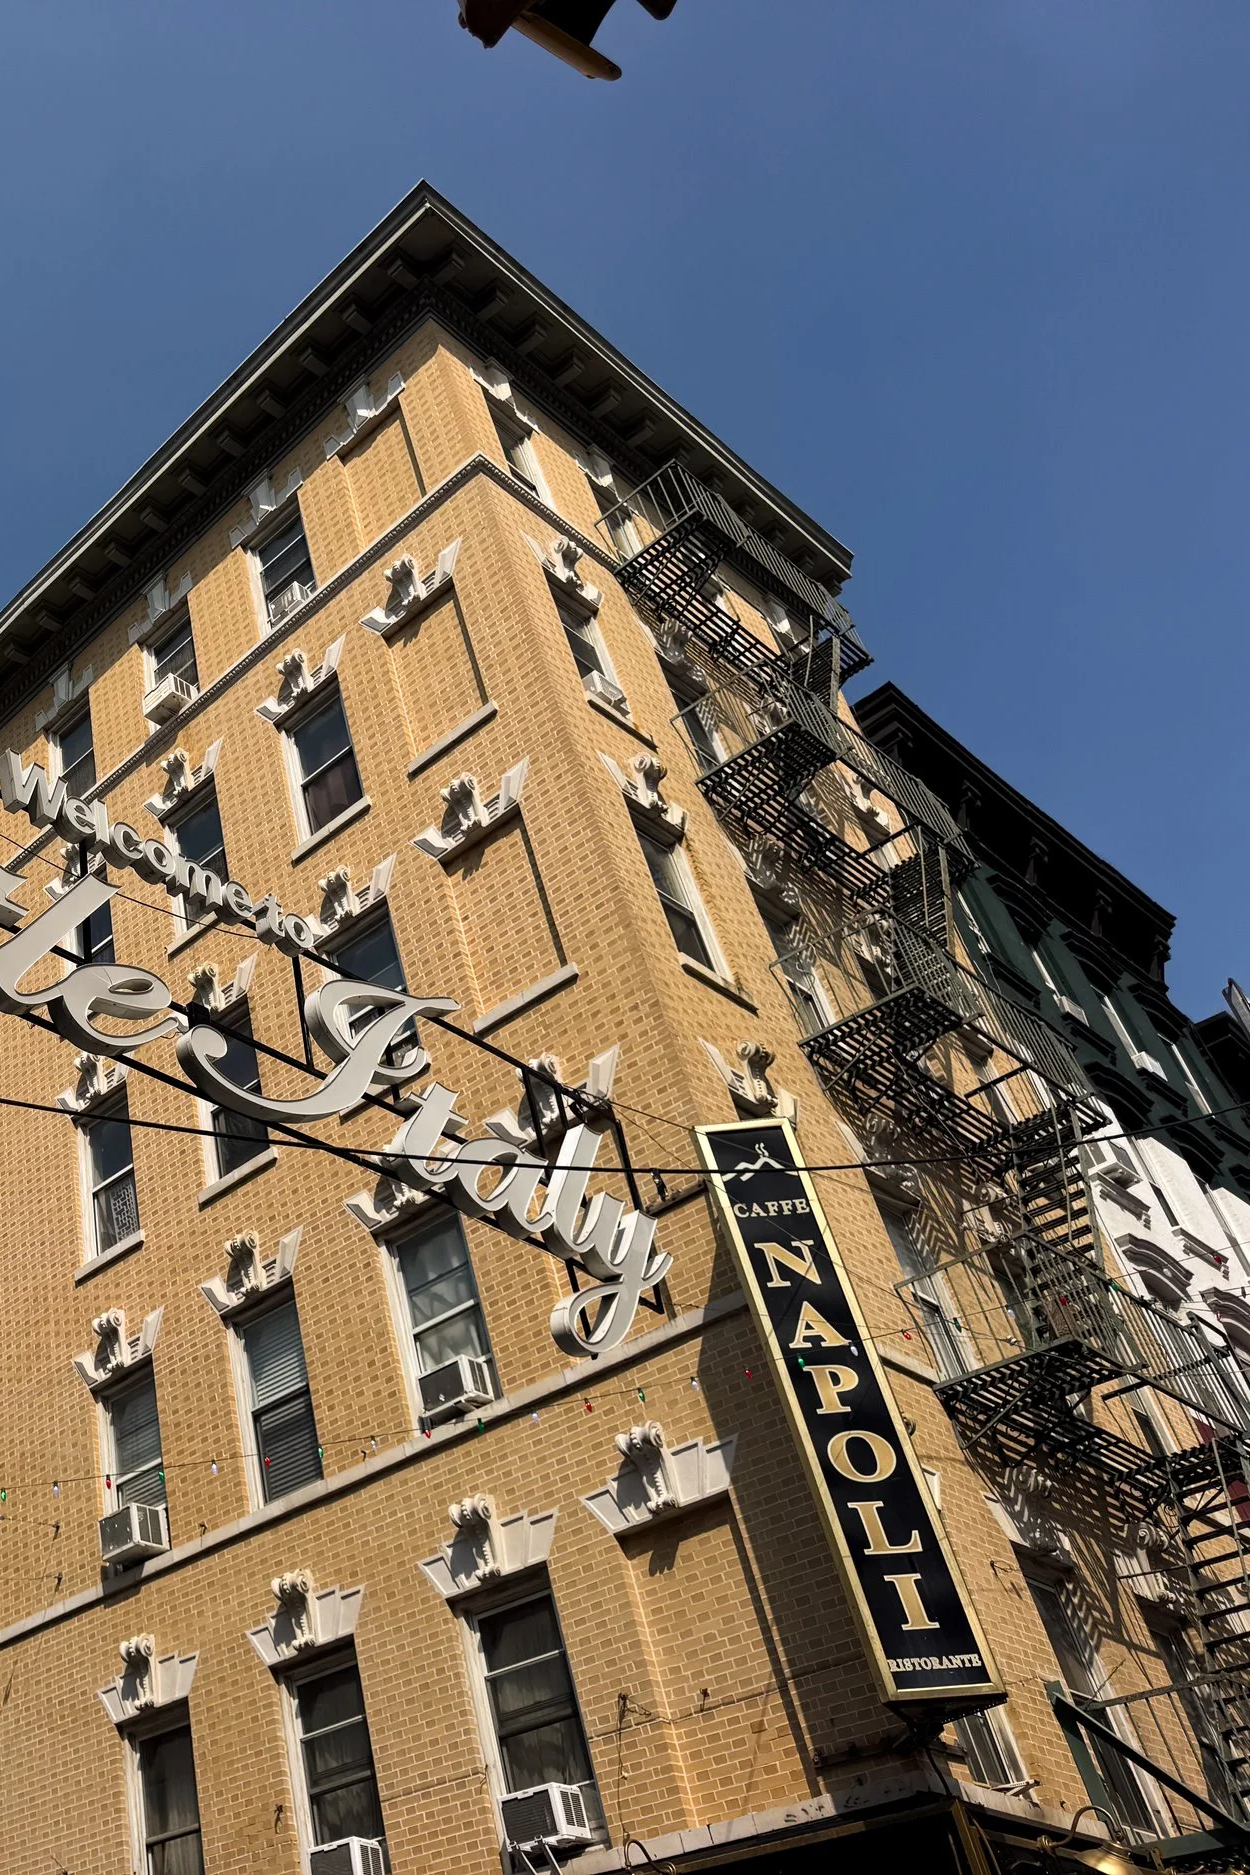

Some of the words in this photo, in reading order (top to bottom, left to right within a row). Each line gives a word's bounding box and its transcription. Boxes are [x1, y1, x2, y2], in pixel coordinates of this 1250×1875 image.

[251, 893, 314, 956] to
[176, 978, 674, 1357] Italy
[733, 1198, 810, 1218] CAFFE
[754, 1240, 940, 1631] NAPOLI
[886, 1653, 982, 1672] RISTORANTE
